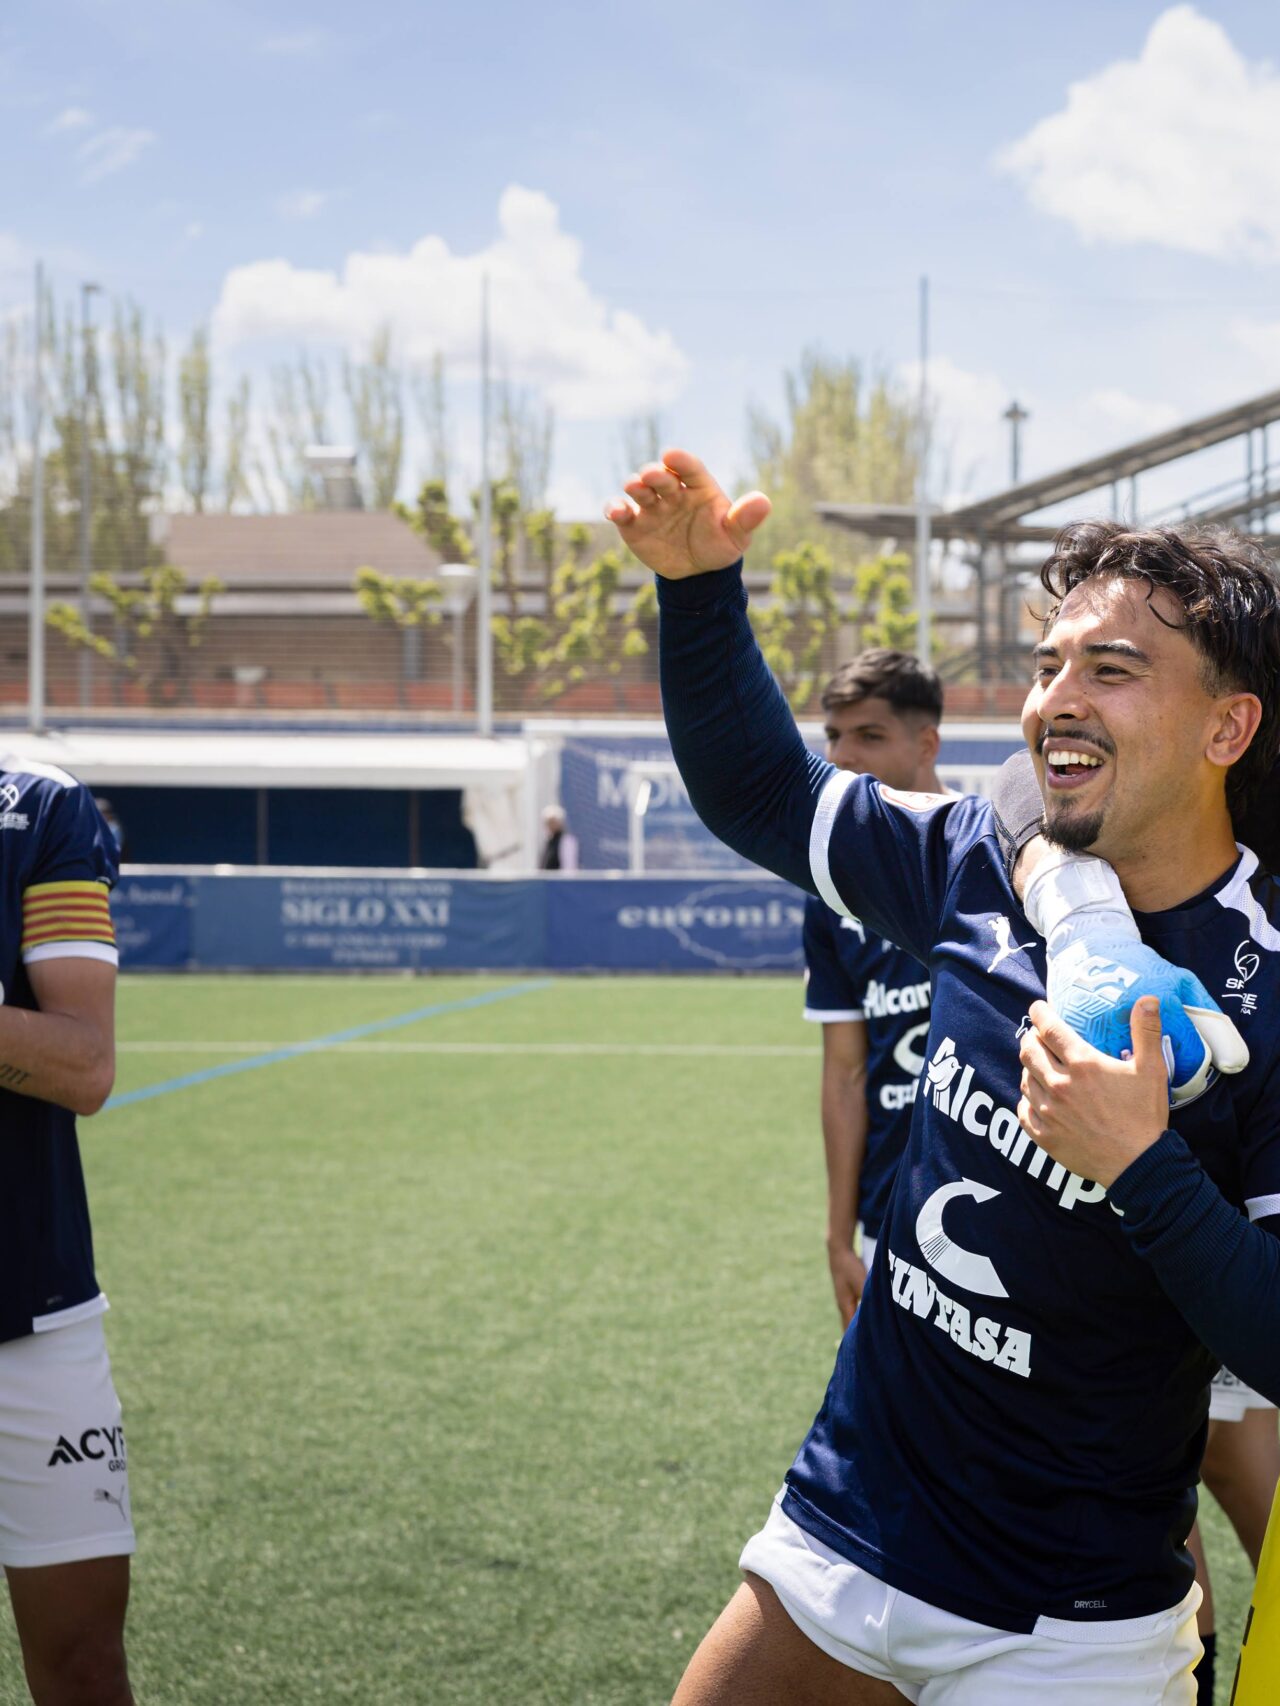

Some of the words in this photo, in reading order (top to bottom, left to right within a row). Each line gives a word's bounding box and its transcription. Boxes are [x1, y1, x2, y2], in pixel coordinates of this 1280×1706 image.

[282, 898, 386, 927] SIGLO
[390, 898, 450, 927] XXI
[888, 1249, 1032, 1378] INTASA
[1074, 1600, 1108, 1609] DRYCELL
